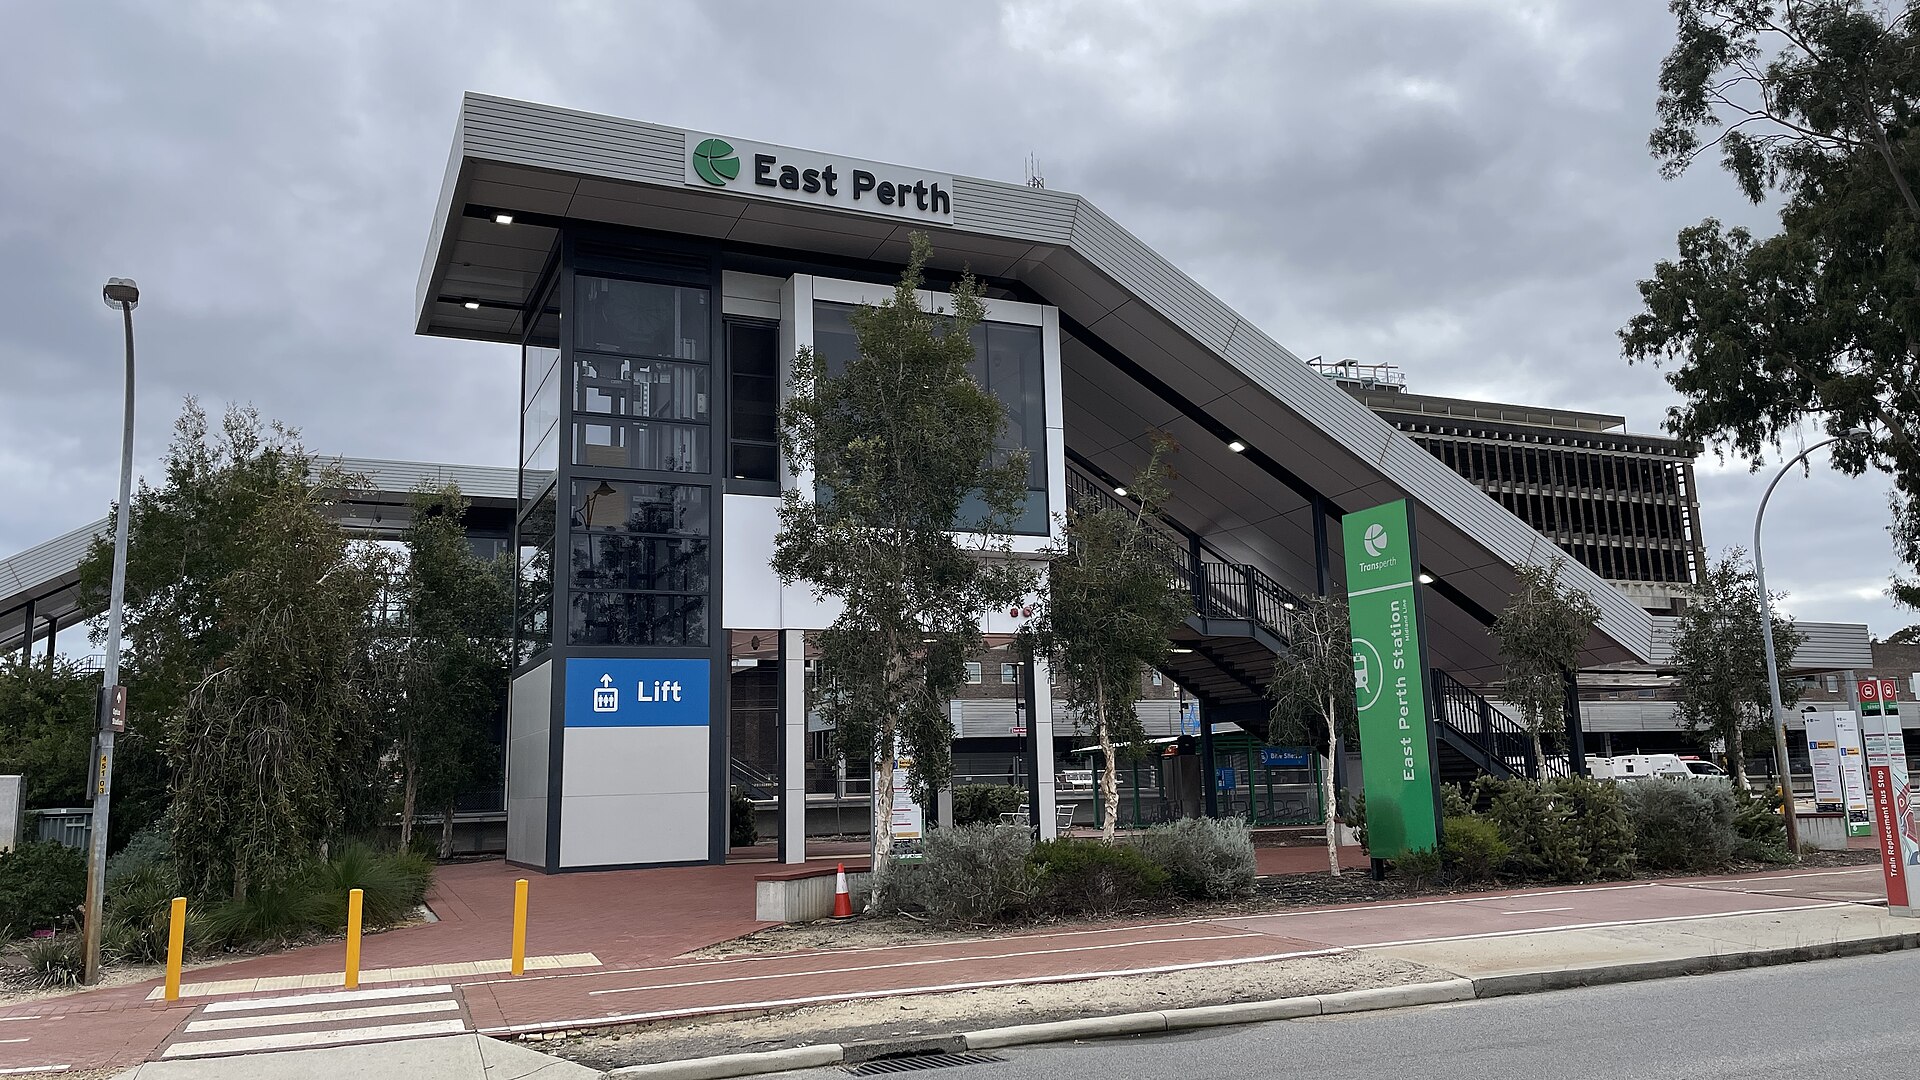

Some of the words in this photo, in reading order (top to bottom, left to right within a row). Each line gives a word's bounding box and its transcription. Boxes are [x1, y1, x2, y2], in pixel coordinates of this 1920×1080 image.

[754, 153, 838, 196] East
[853, 169, 950, 214] Perth
[1359, 556, 1397, 573] Transperth
[1390, 600, 1405, 670] Station
[637, 680, 682, 702] Lift
[1395, 676, 1410, 730] Perth
[1400, 737, 1415, 781] East
[1877, 770, 1885, 788] Stop
[1880, 790, 1888, 805] Bus
[1882, 806, 1895, 856] Replacement
[1888, 857, 1898, 877] Train
